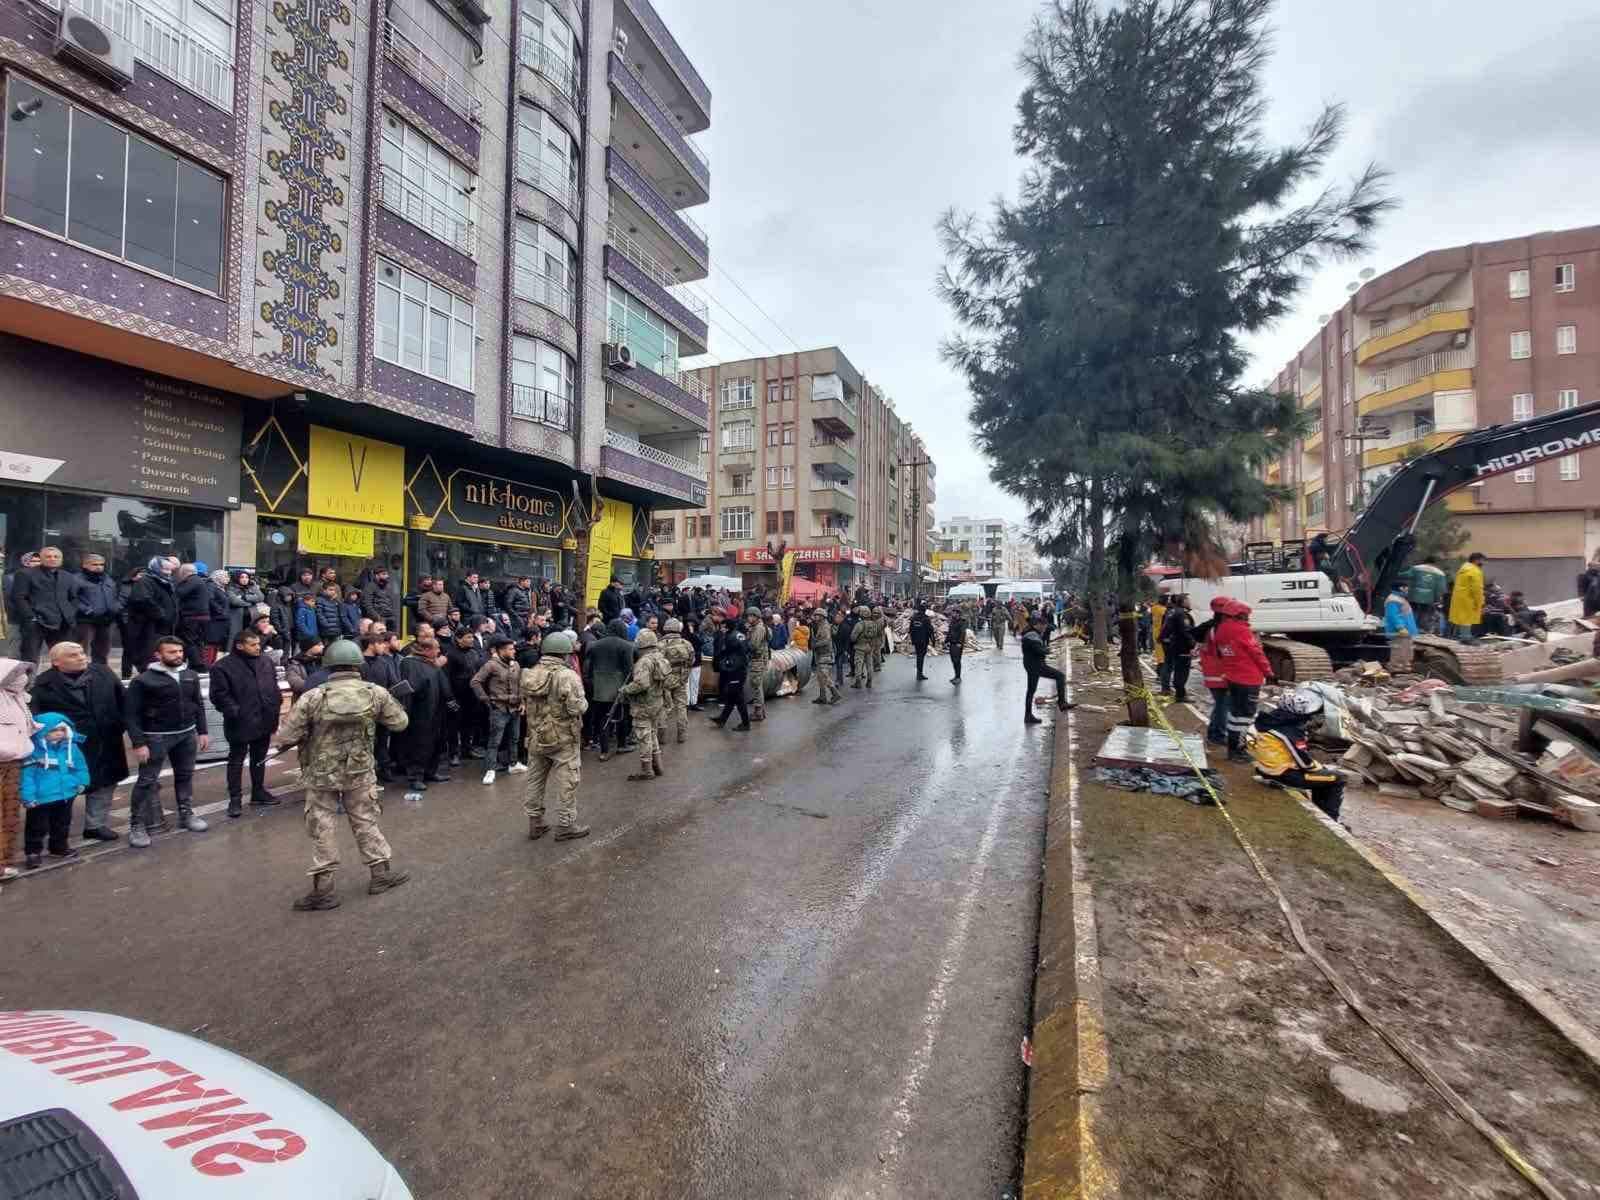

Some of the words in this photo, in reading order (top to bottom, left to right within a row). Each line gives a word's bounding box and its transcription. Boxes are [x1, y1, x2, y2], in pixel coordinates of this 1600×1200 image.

[347, 440, 368, 494] V
[304, 523, 371, 546] VILINZE
[1281, 579, 1320, 591] 310
